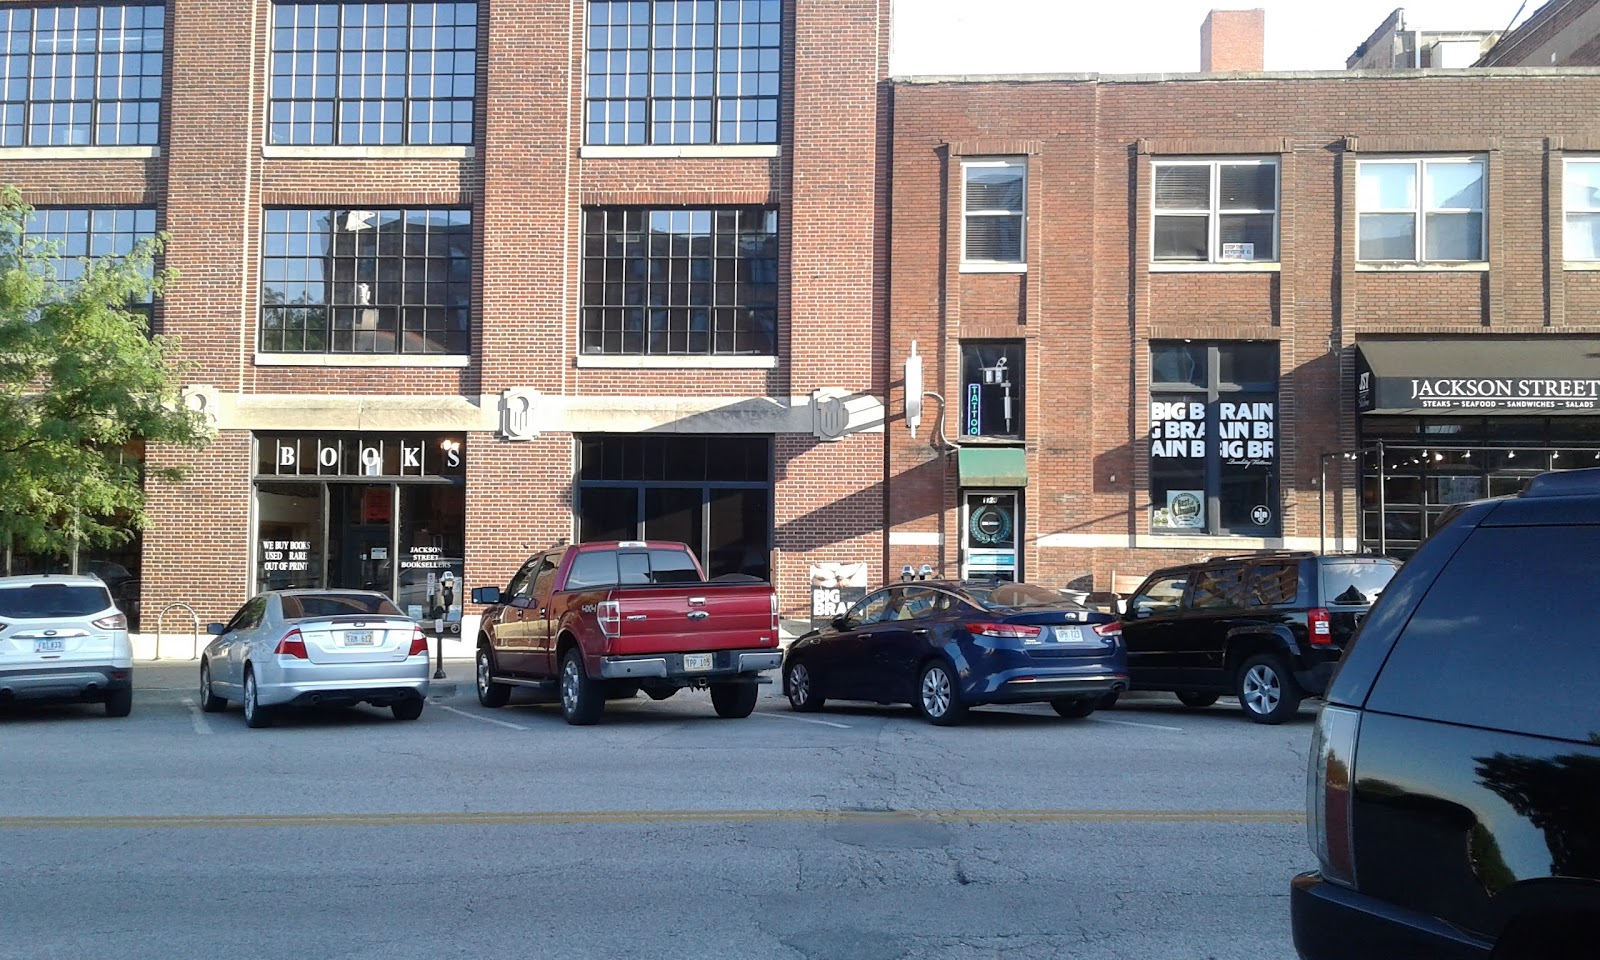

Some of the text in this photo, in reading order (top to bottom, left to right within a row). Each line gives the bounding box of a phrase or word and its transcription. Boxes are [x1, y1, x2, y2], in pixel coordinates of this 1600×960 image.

[1411, 379, 1600, 400] JACKSON STREET
[1422, 400, 1452, 408] STEAKS
[1461, 400, 1497, 408] SEAFOOD
[1151, 402, 1186, 420] BIG
[1219, 440, 1244, 458] IG
[280, 446, 460, 468] BOOKS
[263, 541, 311, 550] WE BUY BOOKS
[265, 551, 307, 560] USED RARE
[264, 561, 309, 571] OUT OF PRINT
[401, 561, 452, 569] BOOKSELLERS
[813, 589, 840, 603] BIG
